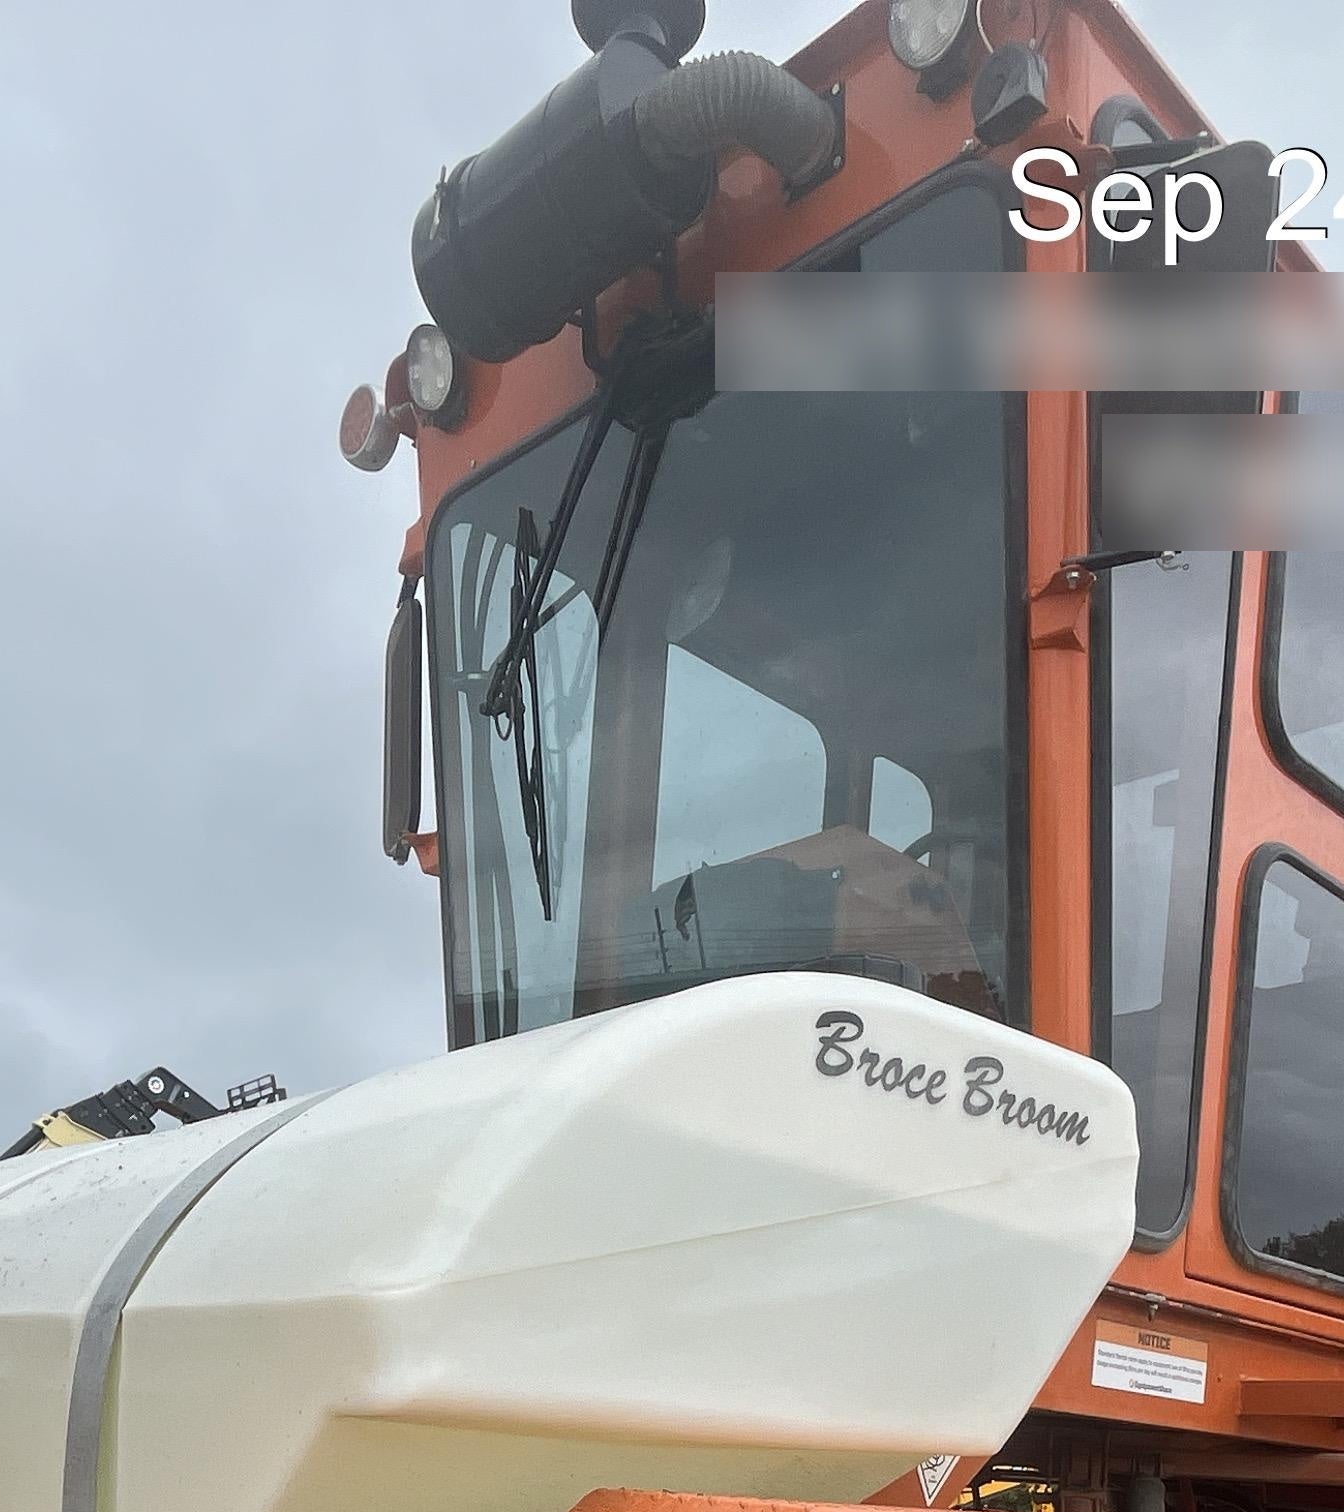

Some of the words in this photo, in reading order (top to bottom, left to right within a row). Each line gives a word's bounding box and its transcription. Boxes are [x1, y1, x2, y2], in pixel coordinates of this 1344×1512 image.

[814, 1009, 947, 1105] Broce
[961, 1055, 1091, 1146] Broom
[1137, 1331, 1171, 1351] NOTICE
